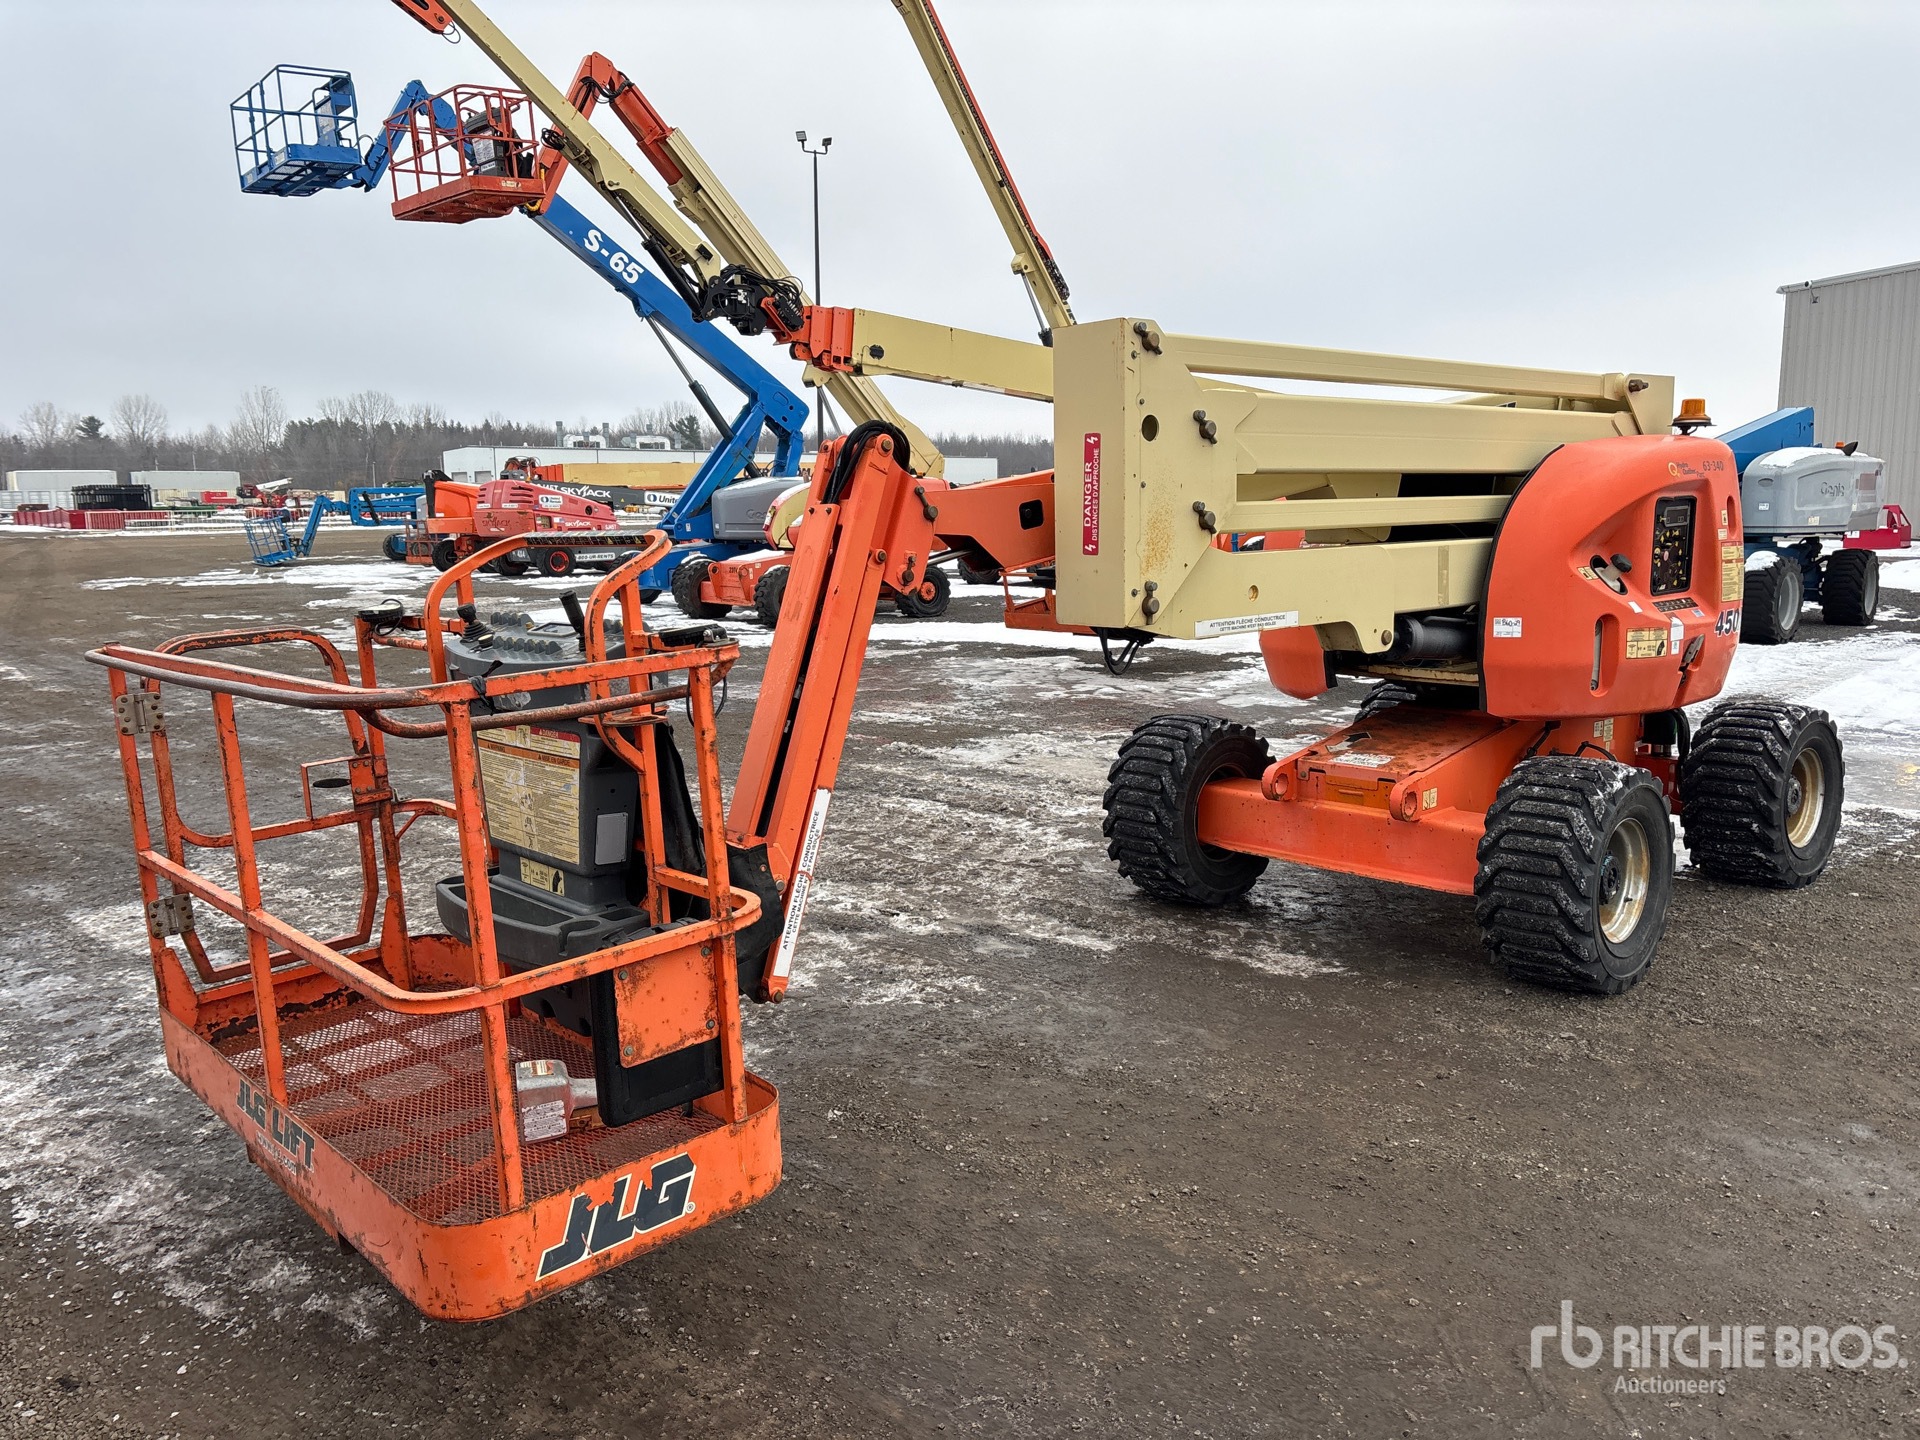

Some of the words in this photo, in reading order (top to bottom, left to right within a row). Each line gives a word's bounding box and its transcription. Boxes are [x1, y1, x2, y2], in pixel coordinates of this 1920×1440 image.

[583, 229, 645, 284] S-65
[1092, 448, 1100, 496] D'APPROCHE
[1702, 461, 1724, 471] 63-340
[560, 485, 612, 498] SKYJACK
[1084, 462, 1093, 527] DANGER
[565, 520, 591, 528] SKYJACK
[1091, 496, 1099, 541] DISTANCES
[1209, 620, 1235, 628] ATTENTION
[1254, 614, 1286, 623] CONDUCTRICE
[782, 904, 797, 950] ATTENTION
[802, 810, 820, 868] CONDUCTRICE
[236, 1078, 266, 1131] JLG
[535, 1151, 697, 1282] JLG
